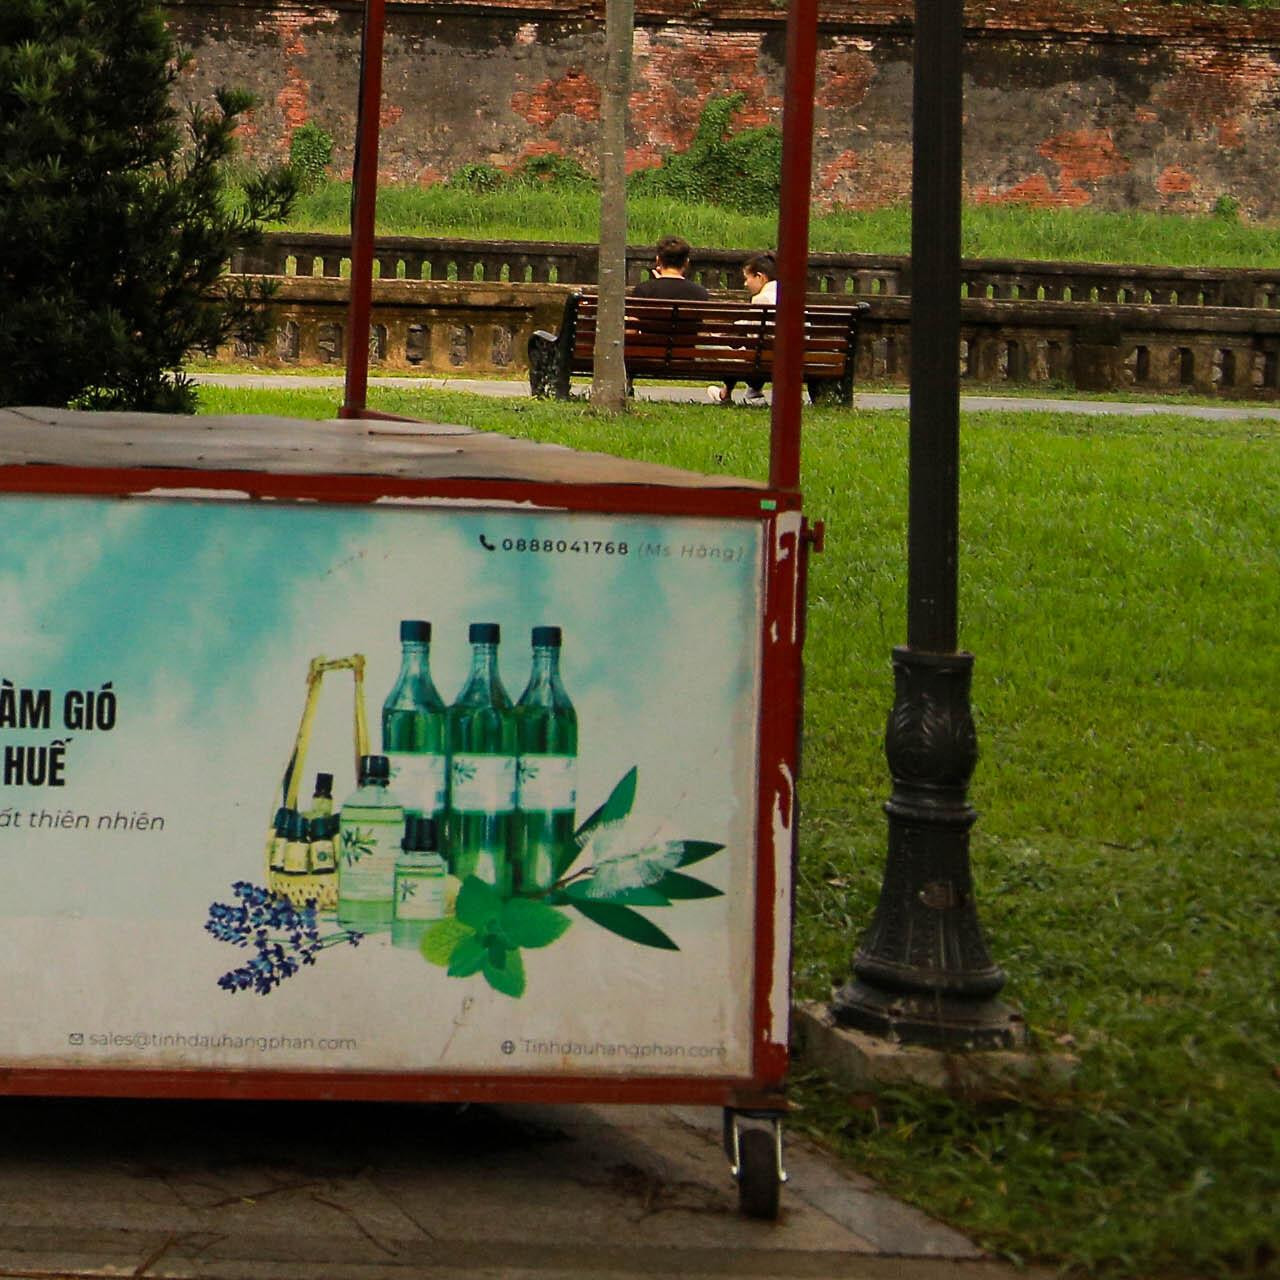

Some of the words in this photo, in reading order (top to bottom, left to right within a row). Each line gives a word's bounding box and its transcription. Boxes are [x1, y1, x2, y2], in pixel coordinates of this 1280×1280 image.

[501, 537, 630, 556] 0888041768
[63, 681, 117, 731] GIÓ
[3, 737, 73, 787] HUẾ
[29, 809, 90, 830] thiên
[97, 811, 165, 832] nhiên
[89, 1031, 358, 1052] sales@tinhdauhangphan.com
